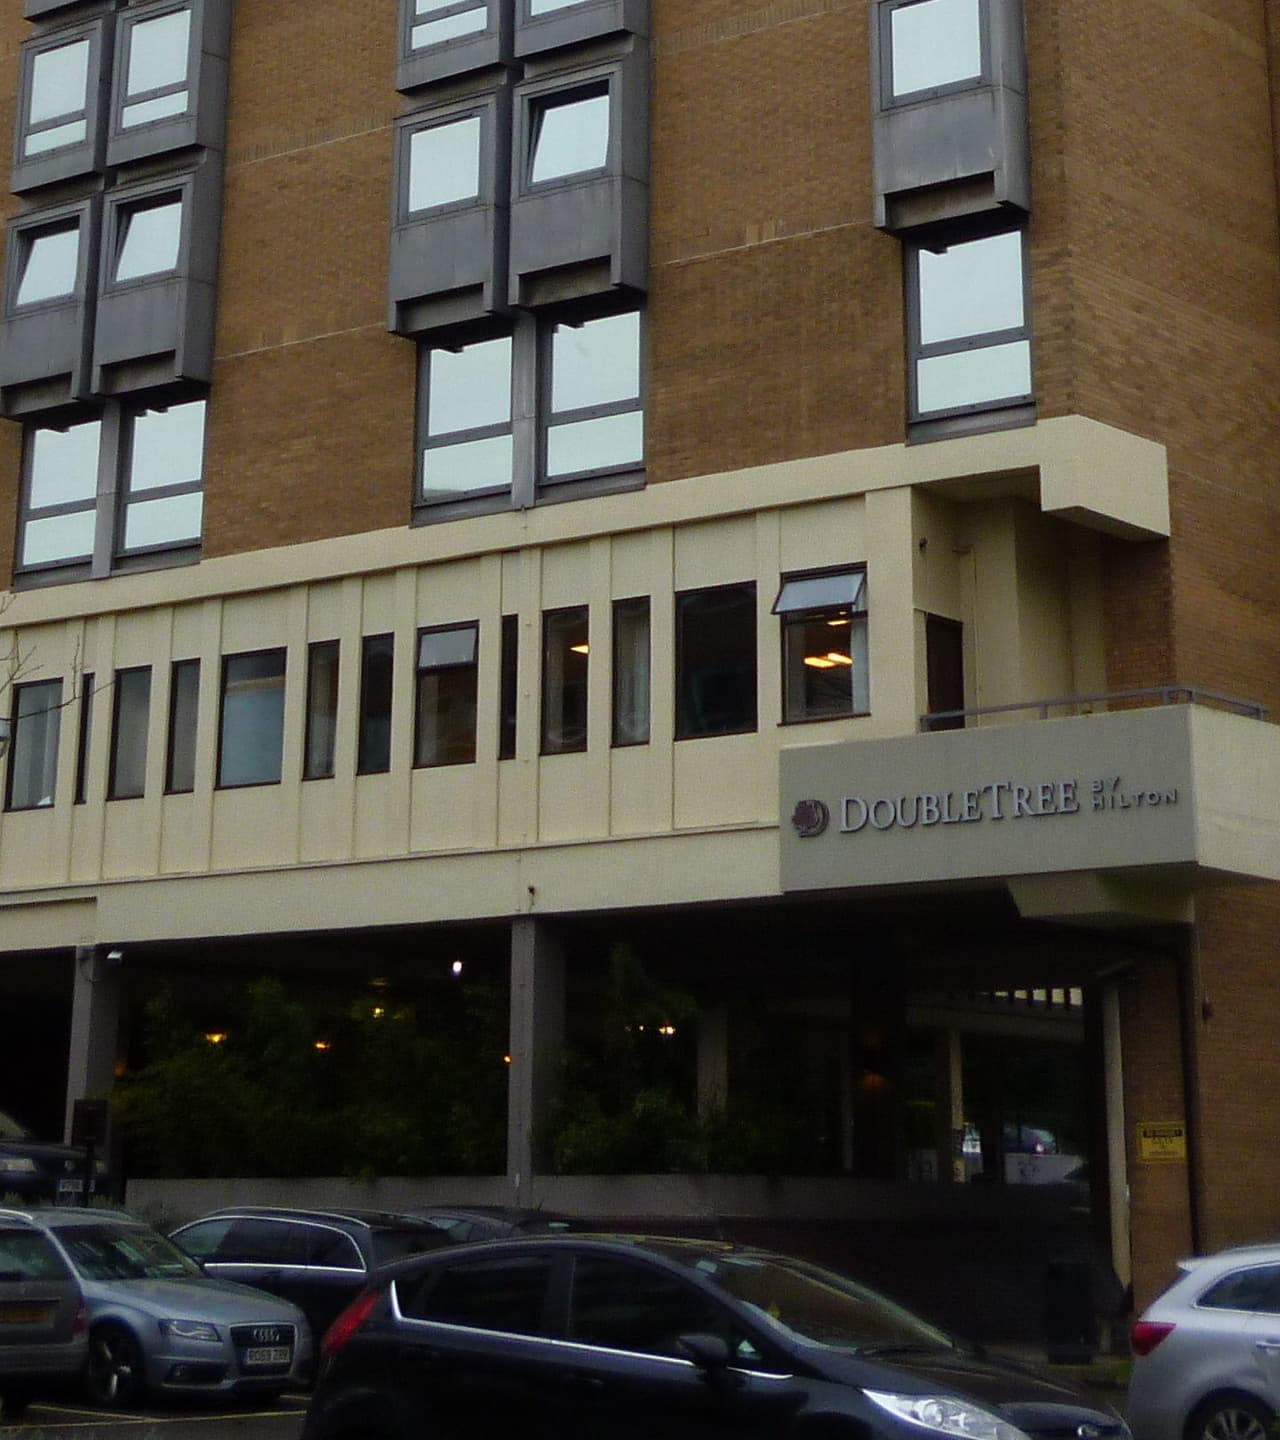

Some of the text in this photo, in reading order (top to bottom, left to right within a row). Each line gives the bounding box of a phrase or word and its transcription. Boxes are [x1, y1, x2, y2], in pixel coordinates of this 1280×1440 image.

[1091, 776, 1121, 794] BY
[839, 778, 1081, 835] DOUBLETREE
[1091, 788, 1179, 812] HILTON
